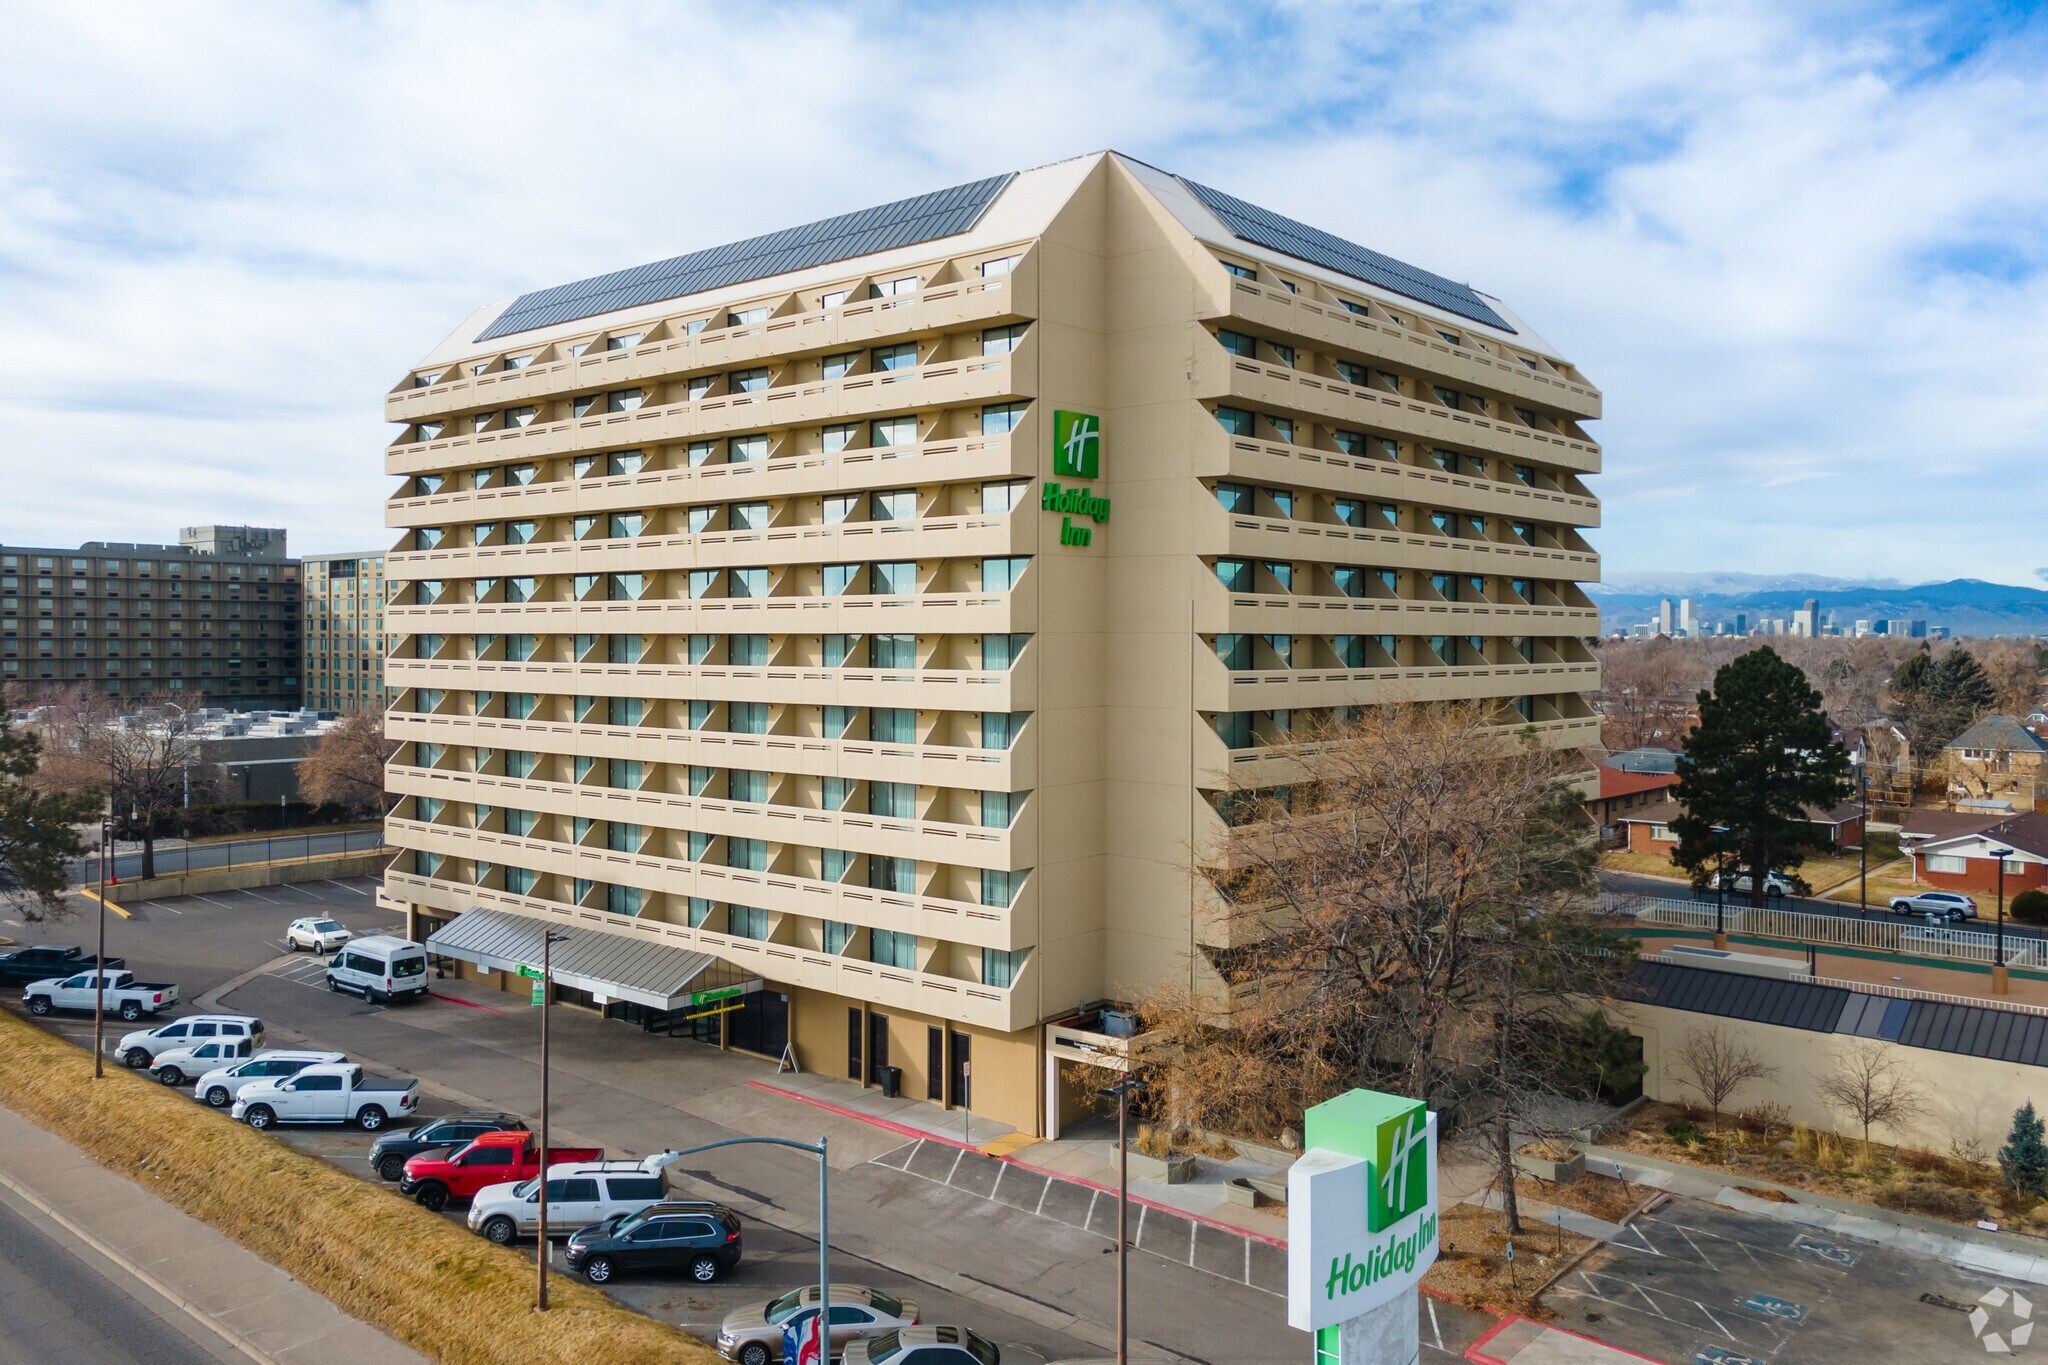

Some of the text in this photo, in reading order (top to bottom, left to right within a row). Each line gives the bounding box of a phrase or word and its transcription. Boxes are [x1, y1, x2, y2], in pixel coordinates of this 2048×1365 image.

[1063, 417, 1099, 473] H
[1042, 482, 1111, 524] Holiday
[1060, 517, 1091, 547] Inn
[1381, 1113, 1427, 1213] H
[1325, 1212, 1436, 1300] Holiday Inn
